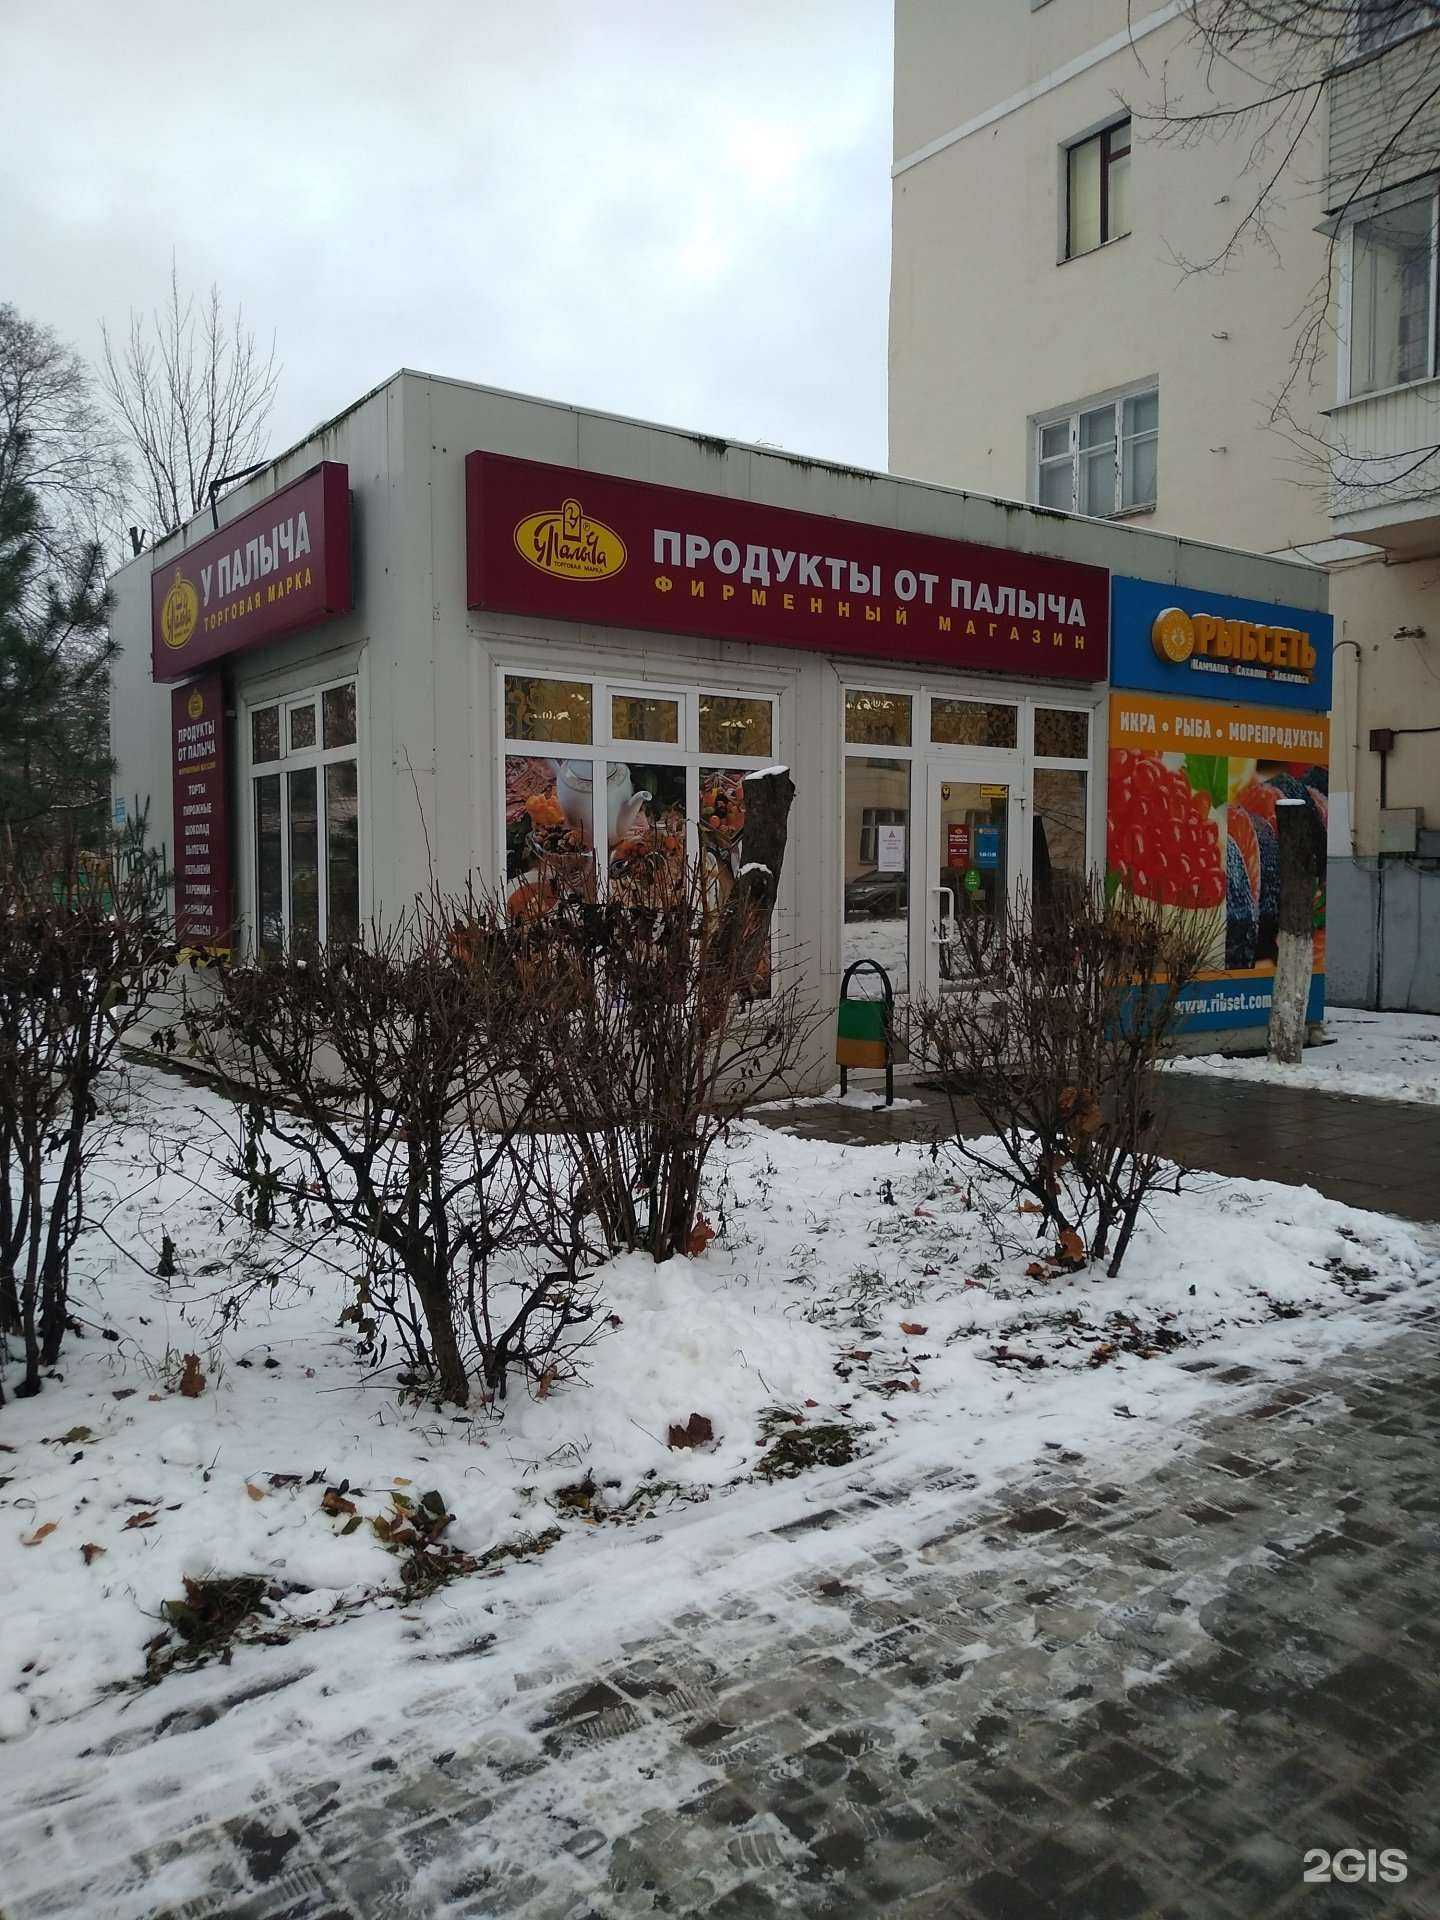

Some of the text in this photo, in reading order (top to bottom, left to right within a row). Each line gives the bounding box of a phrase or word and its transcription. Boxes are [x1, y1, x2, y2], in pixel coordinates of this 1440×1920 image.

[200, 511, 311, 607] У ПАЛЫЧА
[653, 529, 1086, 627] ПРОДУКТЫ ОТ ПАЛЫЧА
[204, 591, 261, 632] ТОРГОВАЯ
[268, 567, 312, 602] МАРКА
[655, 576, 1085, 650] ФИРМЕННЫЙ МАГАЗИН
[1194, 614, 1316, 667] РЫБСЕТЬ
[178, 719, 215, 743] ПРОДУКТЫ
[178, 739, 216, 762] ОТ ПАЛЫЧА
[1120, 711, 1323, 749] ИКРА РЫБА МОРЕПРОДУКТЫ
